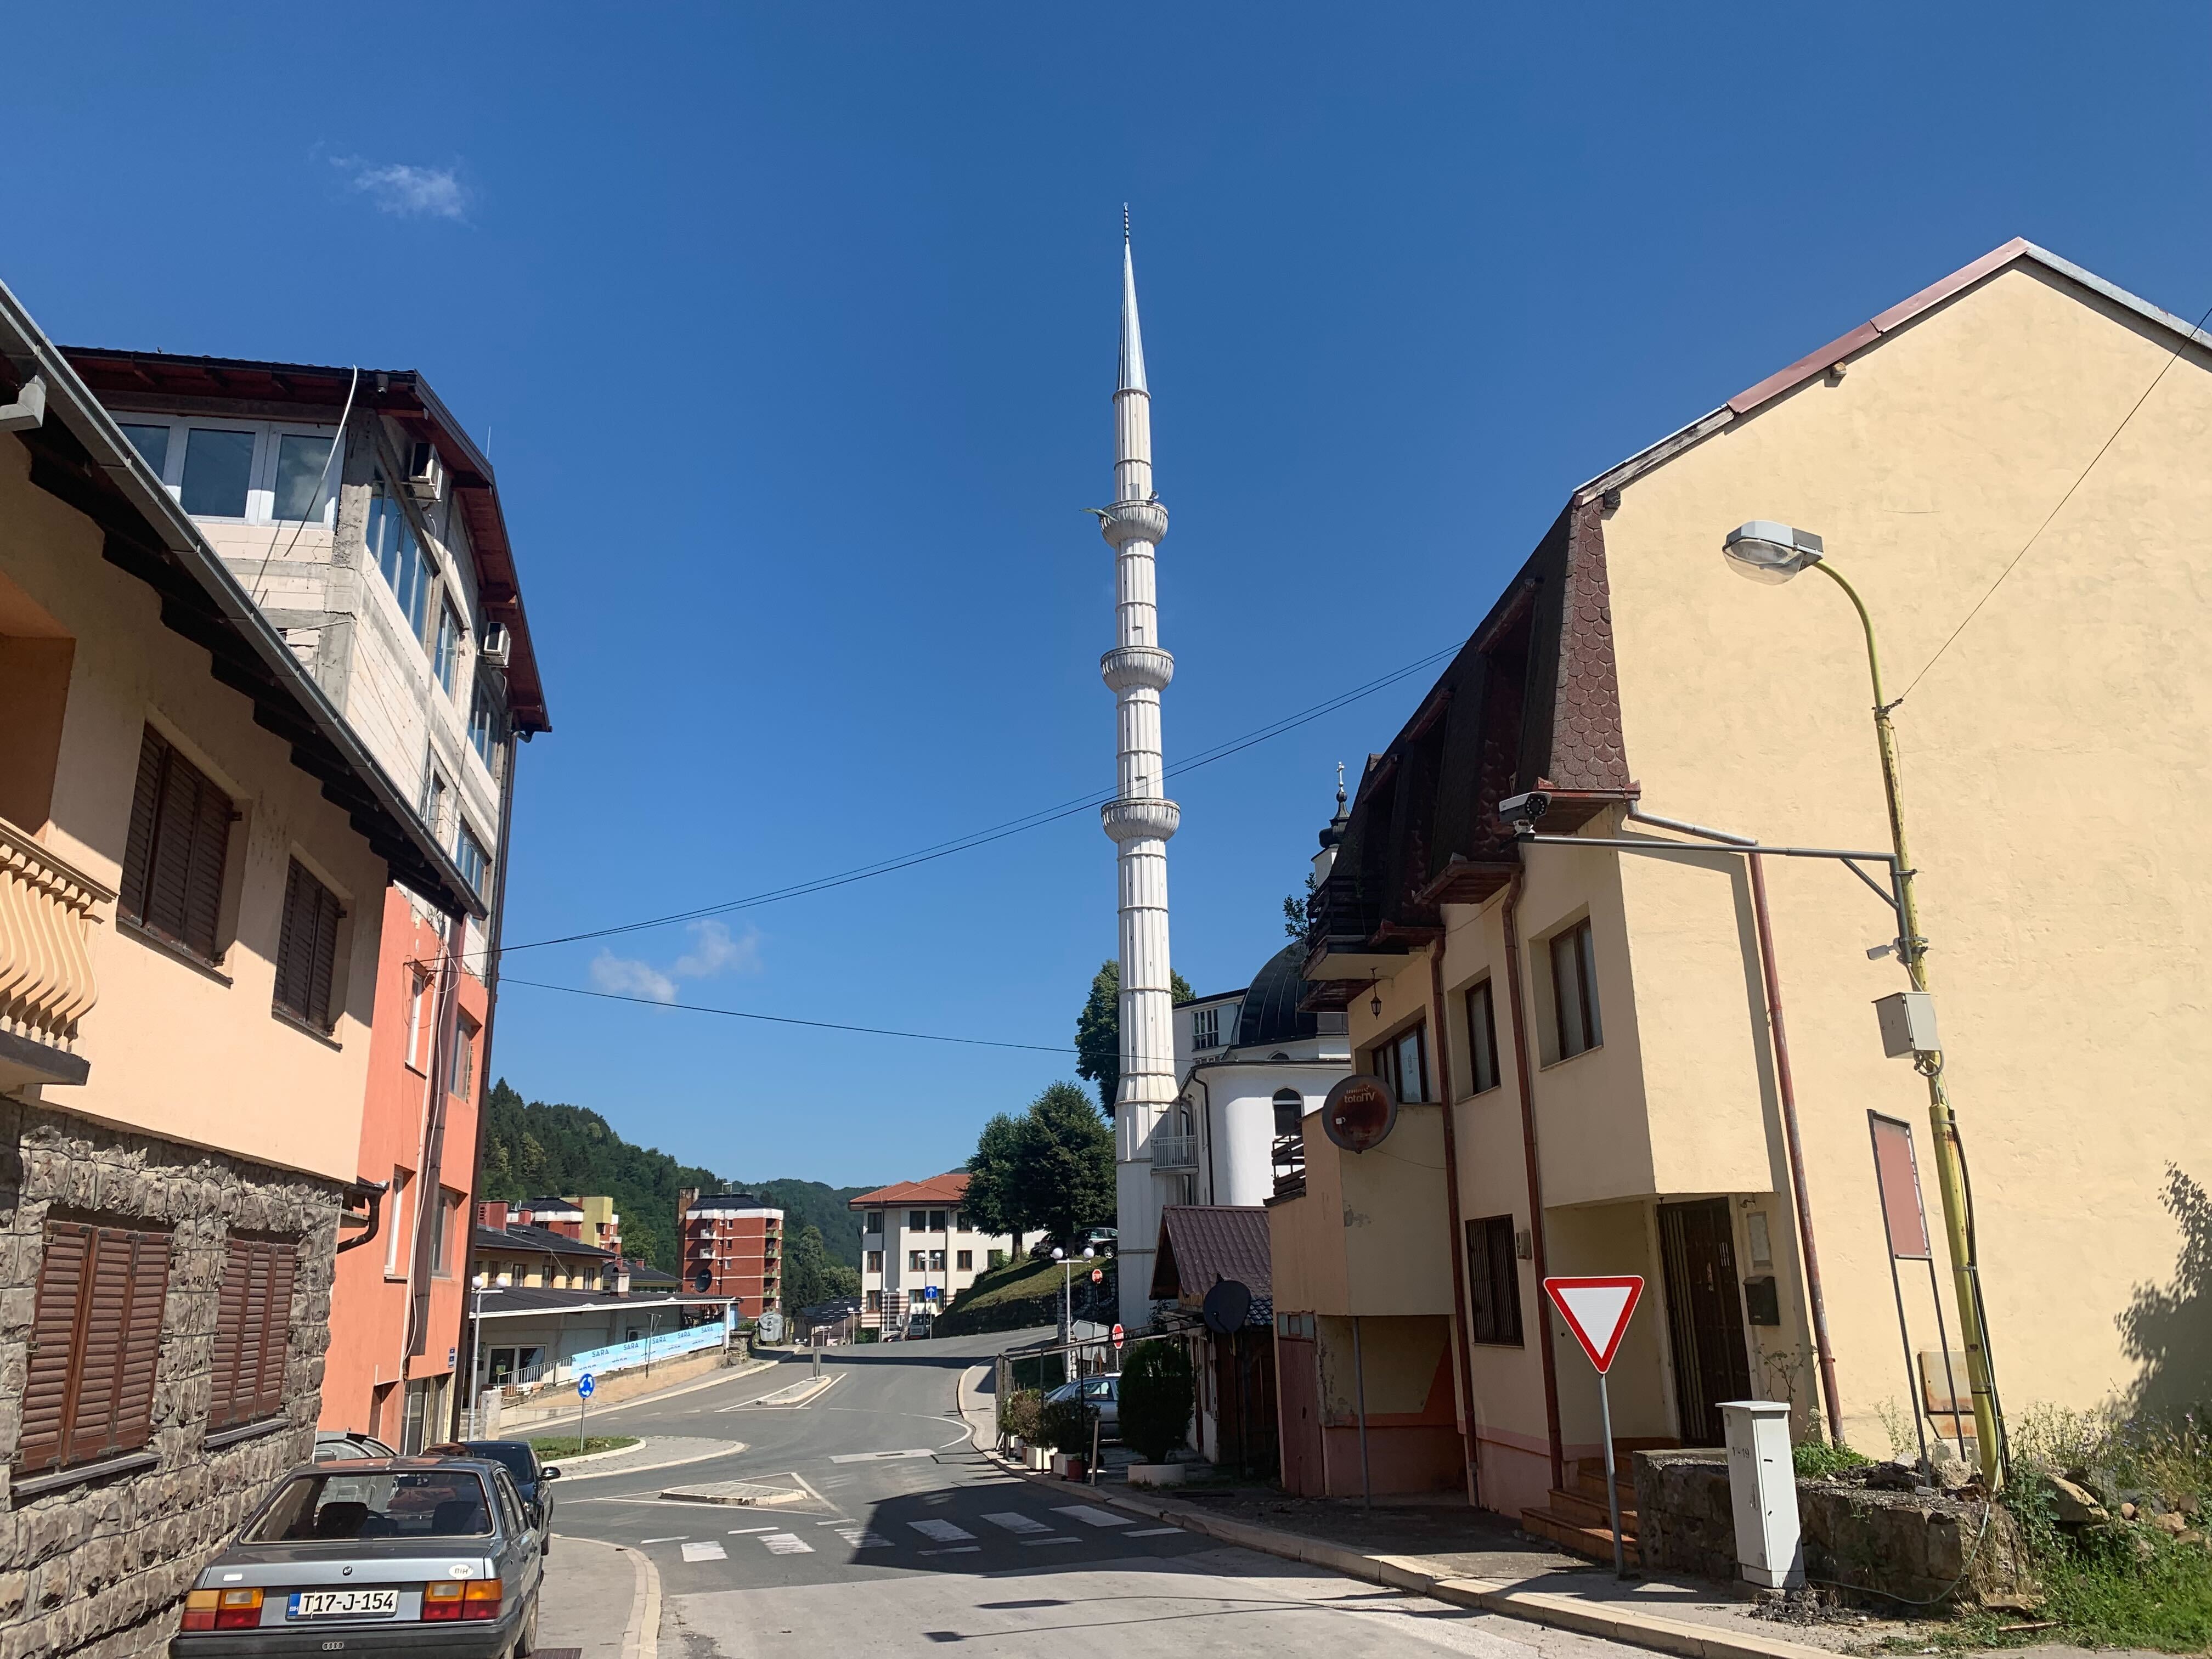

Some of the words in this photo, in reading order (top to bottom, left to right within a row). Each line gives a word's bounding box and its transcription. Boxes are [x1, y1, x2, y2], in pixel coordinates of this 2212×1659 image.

[1344, 1092, 1375, 1103] totalTV
[592, 1349, 609, 1357] SARA
[303, 1593, 393, 1612] T17-J-154
